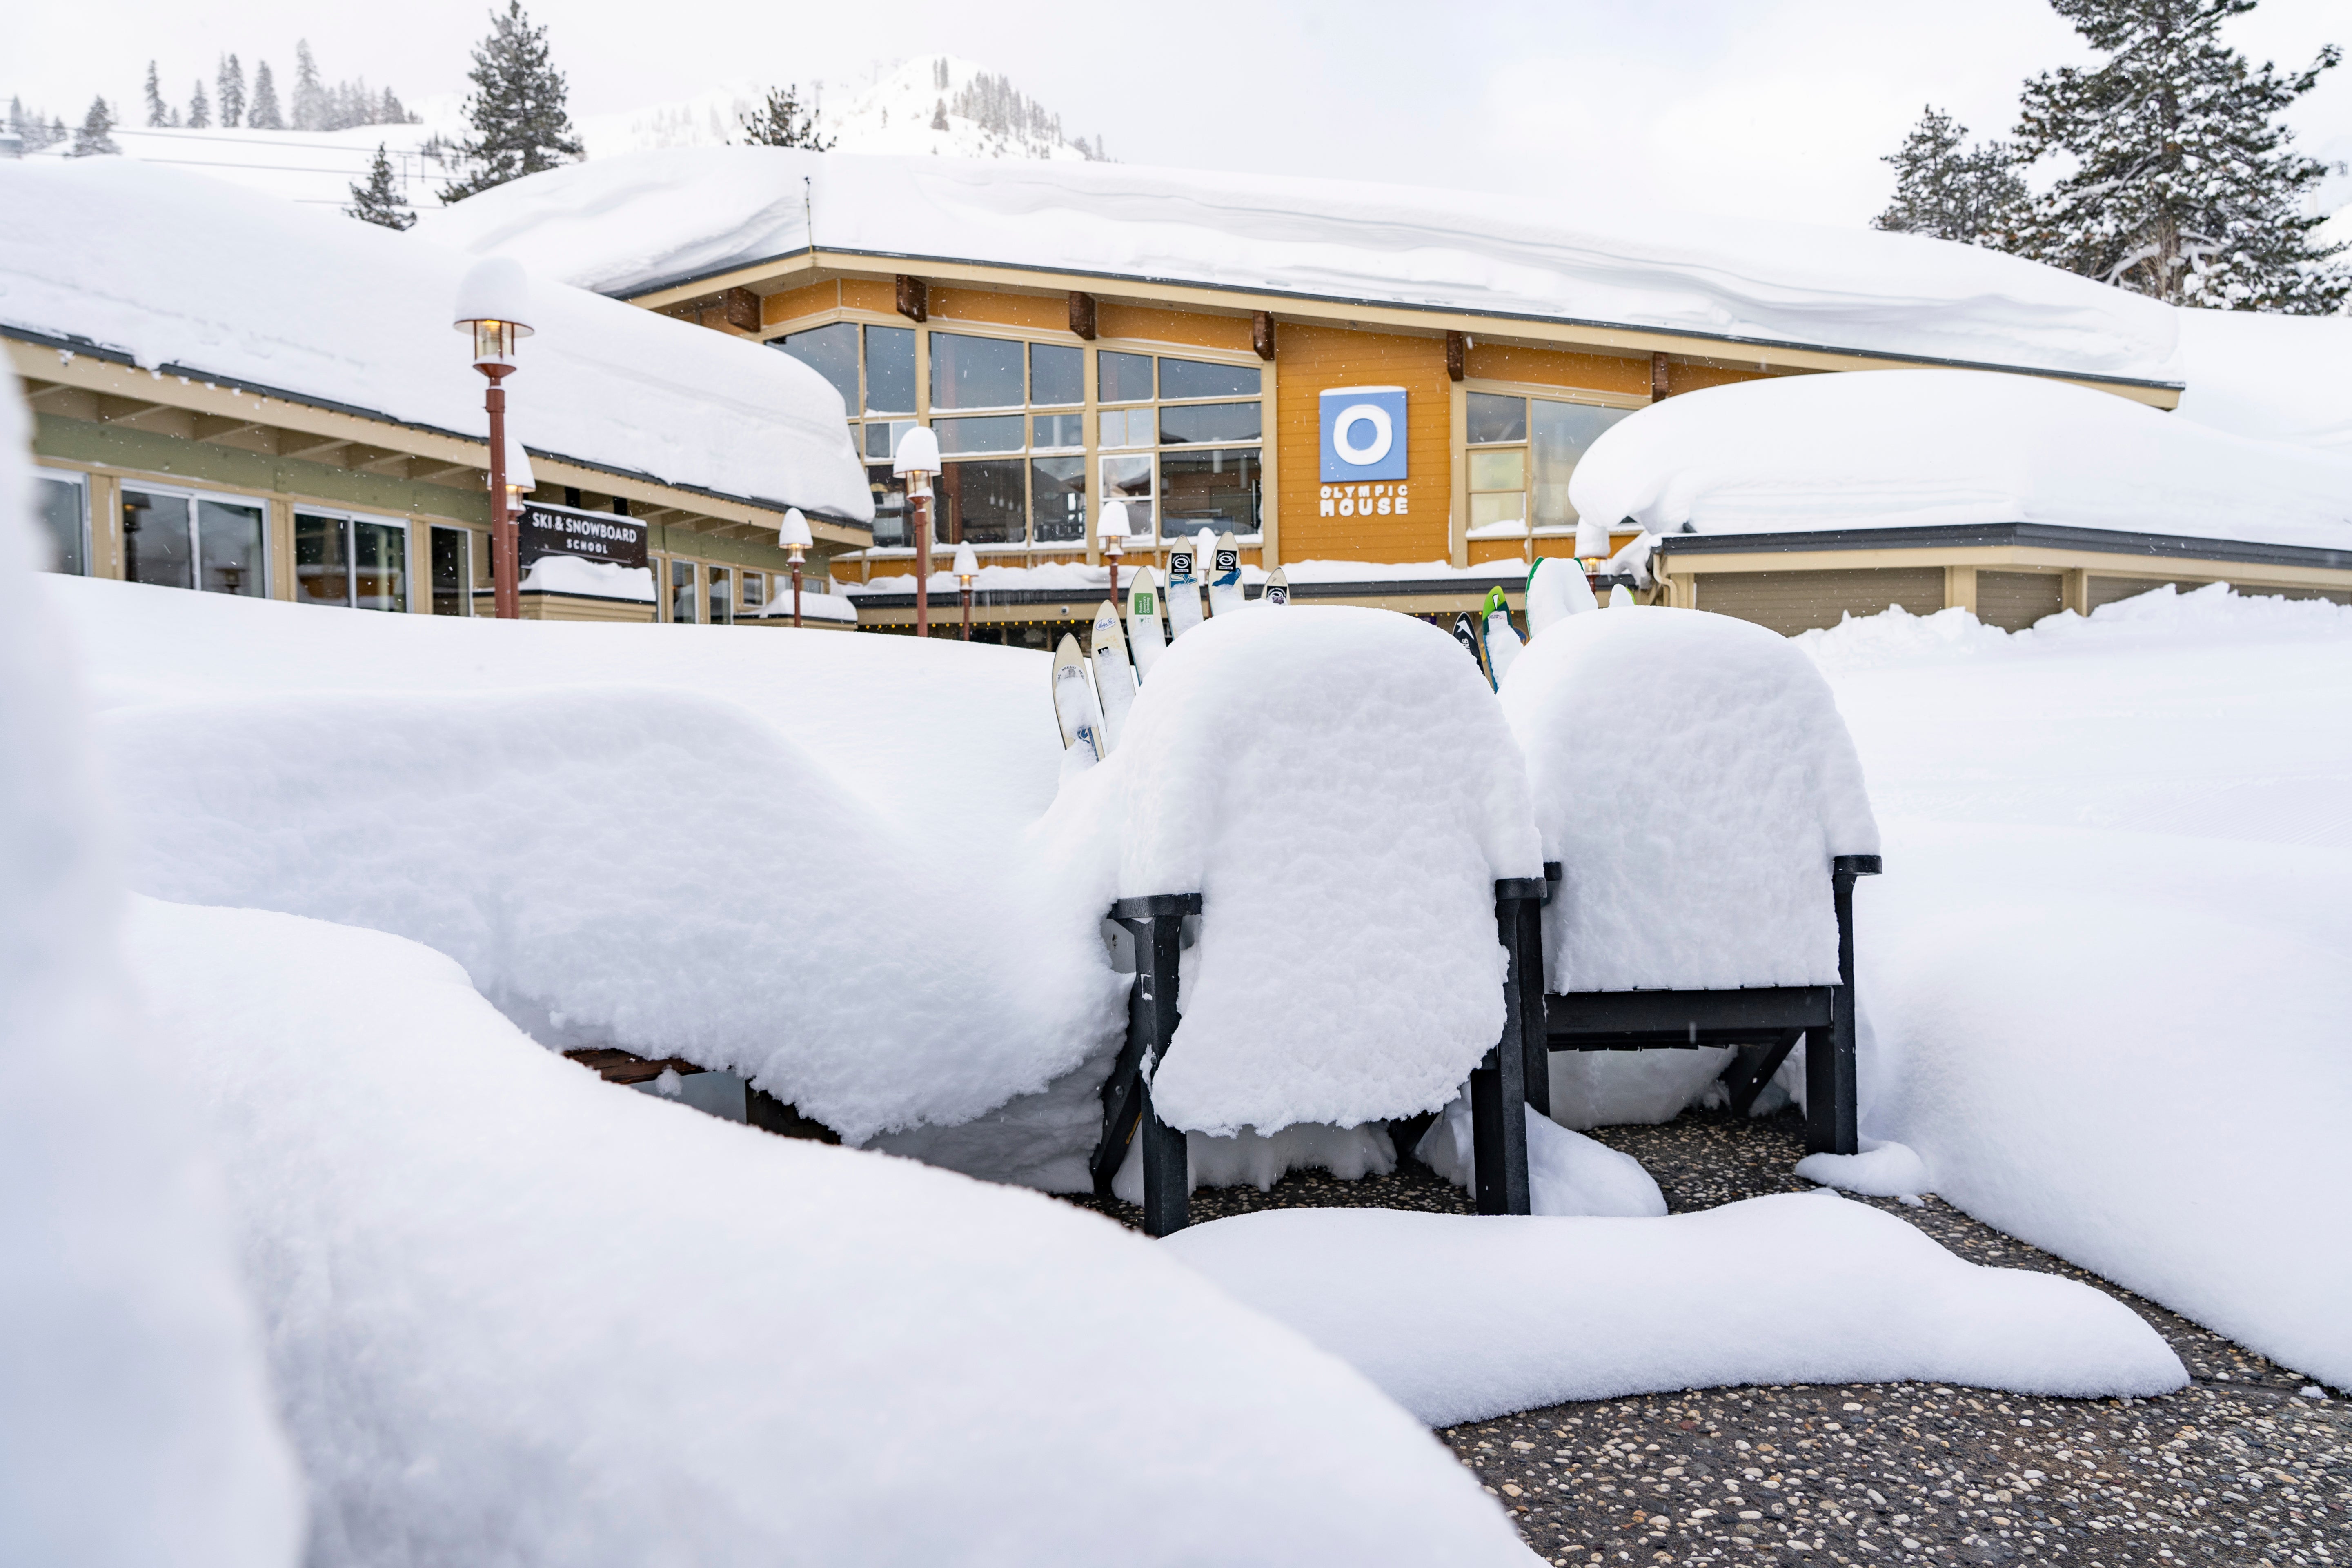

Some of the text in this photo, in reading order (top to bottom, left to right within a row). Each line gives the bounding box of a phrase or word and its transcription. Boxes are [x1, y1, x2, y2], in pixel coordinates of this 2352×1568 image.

[1320, 485, 1408, 499] OLYMPIC
[1320, 497, 1408, 517] HOUSE
[532, 512, 637, 543] SKI & SNOWBOARD
[566, 538, 608, 554] SCHOOL
